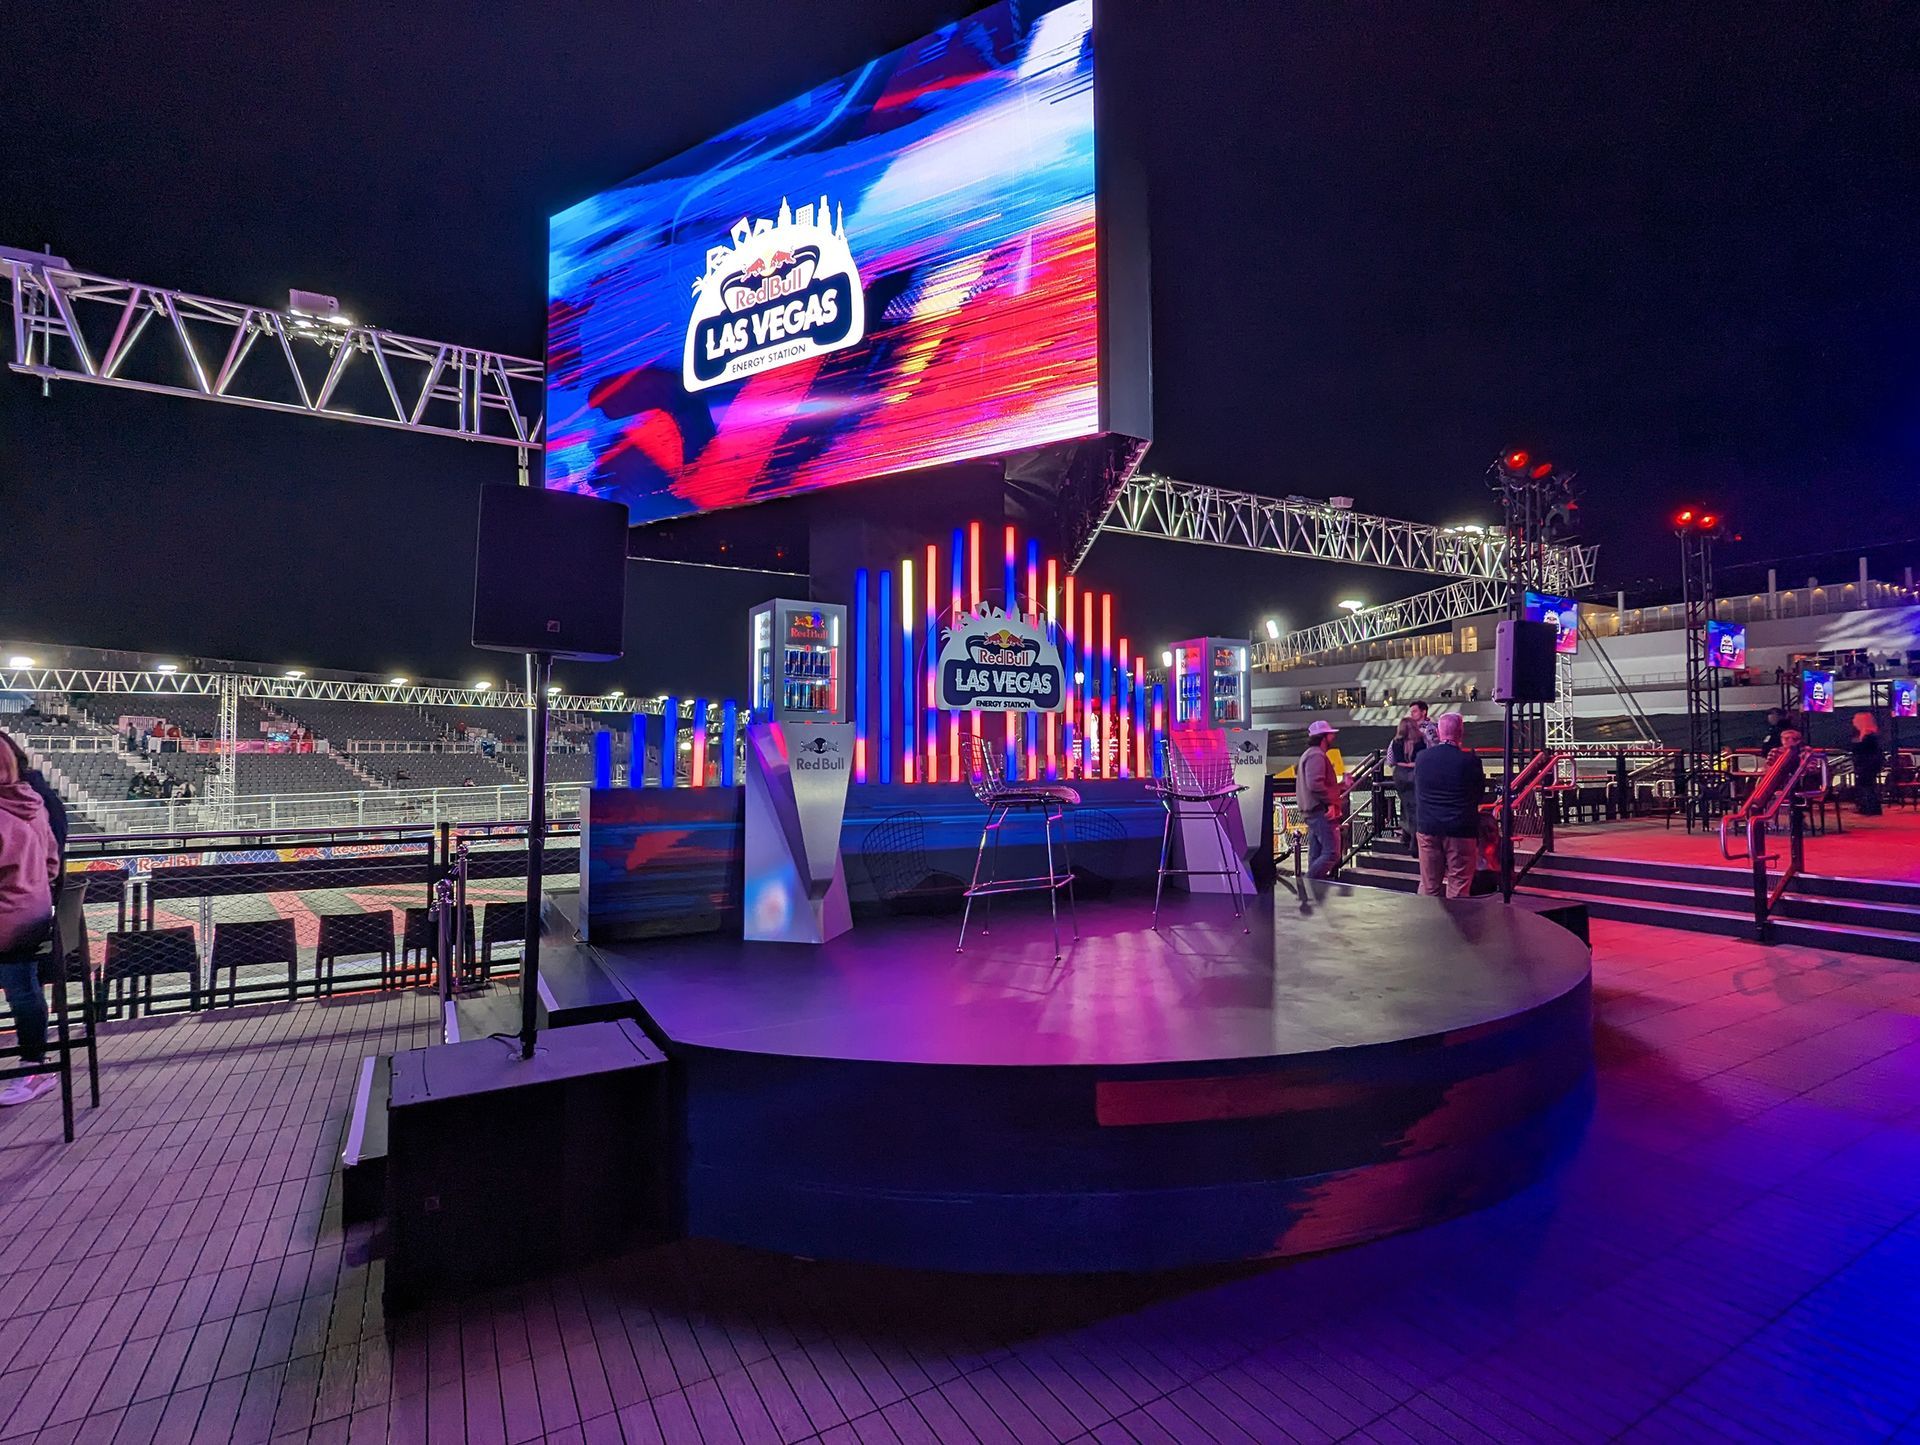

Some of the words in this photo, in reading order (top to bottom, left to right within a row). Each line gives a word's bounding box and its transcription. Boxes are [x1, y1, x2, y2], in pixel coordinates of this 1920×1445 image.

[735, 276, 767, 310] Red
[769, 267, 802, 301] Bull
[705, 318, 748, 361] LAS
[751, 288, 838, 345] VEGAS
[732, 354, 765, 374] ENERGY
[768, 344, 807, 363] STATION
[979, 650, 1004, 665] Red
[1006, 650, 1029, 666] Bull
[955, 668, 990, 692] LAS
[992, 670, 1052, 695] VEGAS
[976, 700, 1002, 708] ENERGY
[1003, 700, 1031, 709] STATION
[796, 757, 820, 770] Red
[822, 757, 845, 770] Bull
[1234, 755, 1248, 765] Red
[1249, 755, 1263, 765] Bull
[138, 855, 174, 872] Red
[176, 853, 202, 868] Bu
